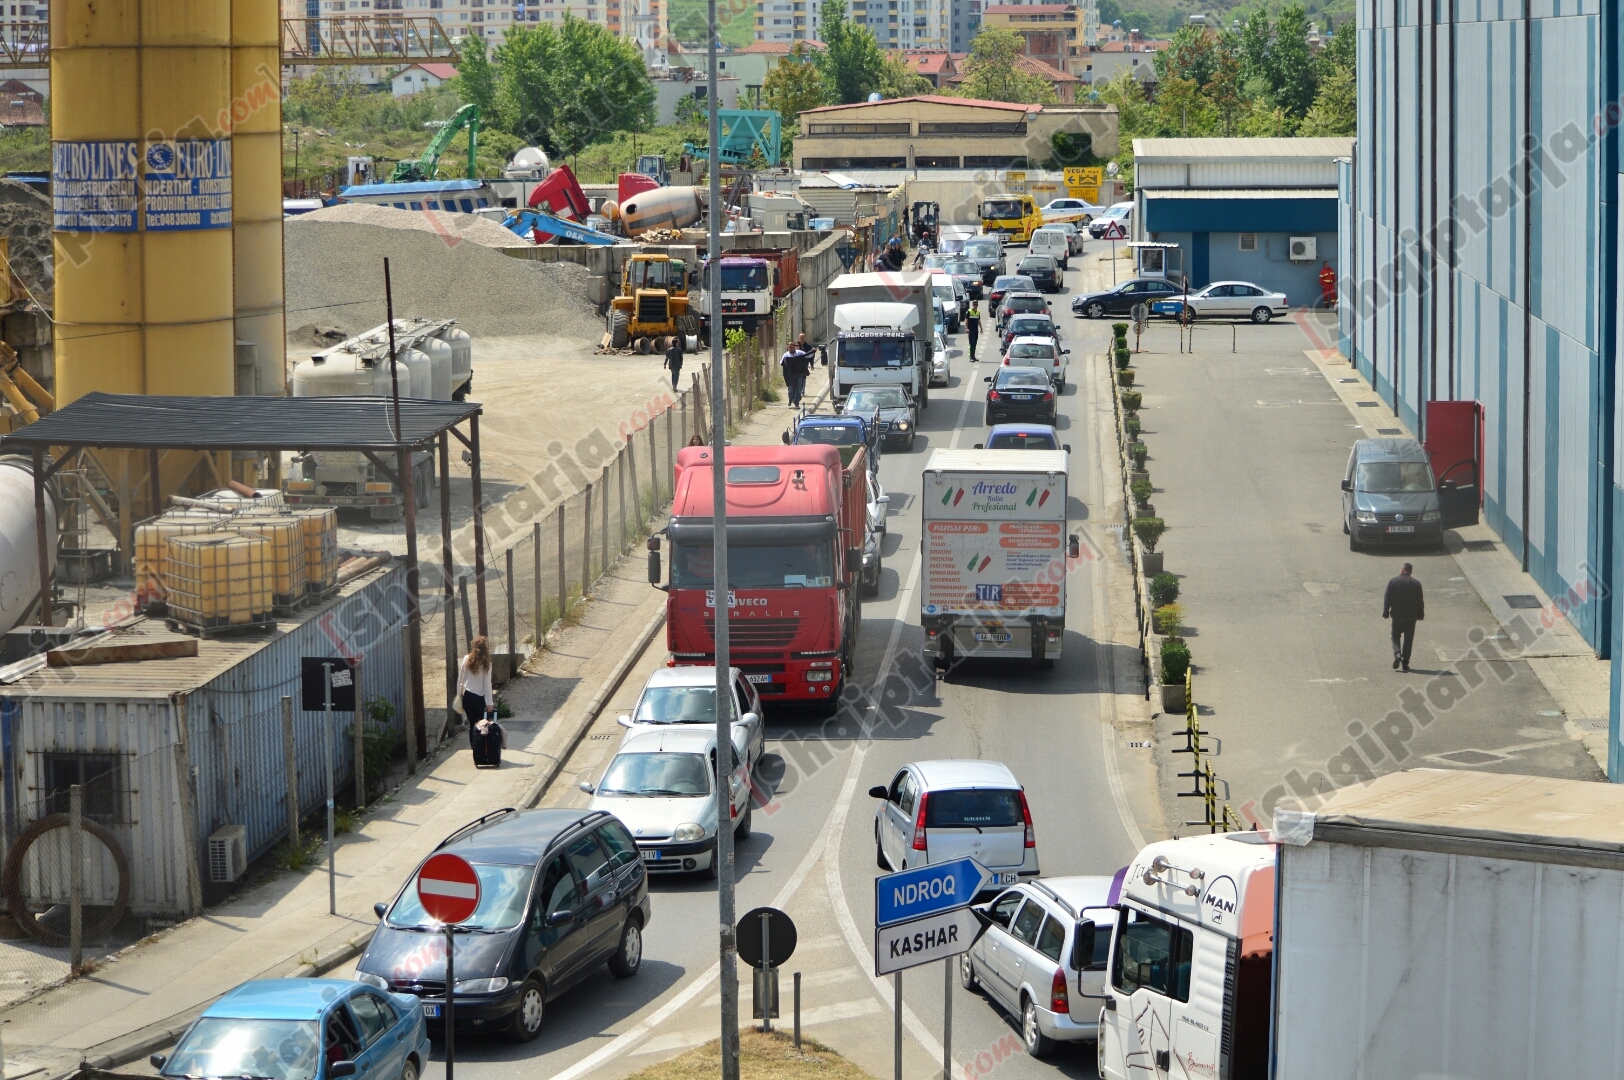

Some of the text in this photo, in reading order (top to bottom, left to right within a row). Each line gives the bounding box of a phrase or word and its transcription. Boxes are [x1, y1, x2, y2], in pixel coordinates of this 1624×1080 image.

[565, 230, 584, 241] O&K
[971, 481, 1018, 495] Arredo
[971, 501, 1017, 512] Profesional
[977, 585, 999, 600] TIR
[735, 598, 768, 606] IVECO
[1005, 875, 1016, 883] CH
[893, 874, 955, 908] NDROQ
[1205, 893, 1235, 914] MAN
[890, 924, 958, 959] KASHAR
